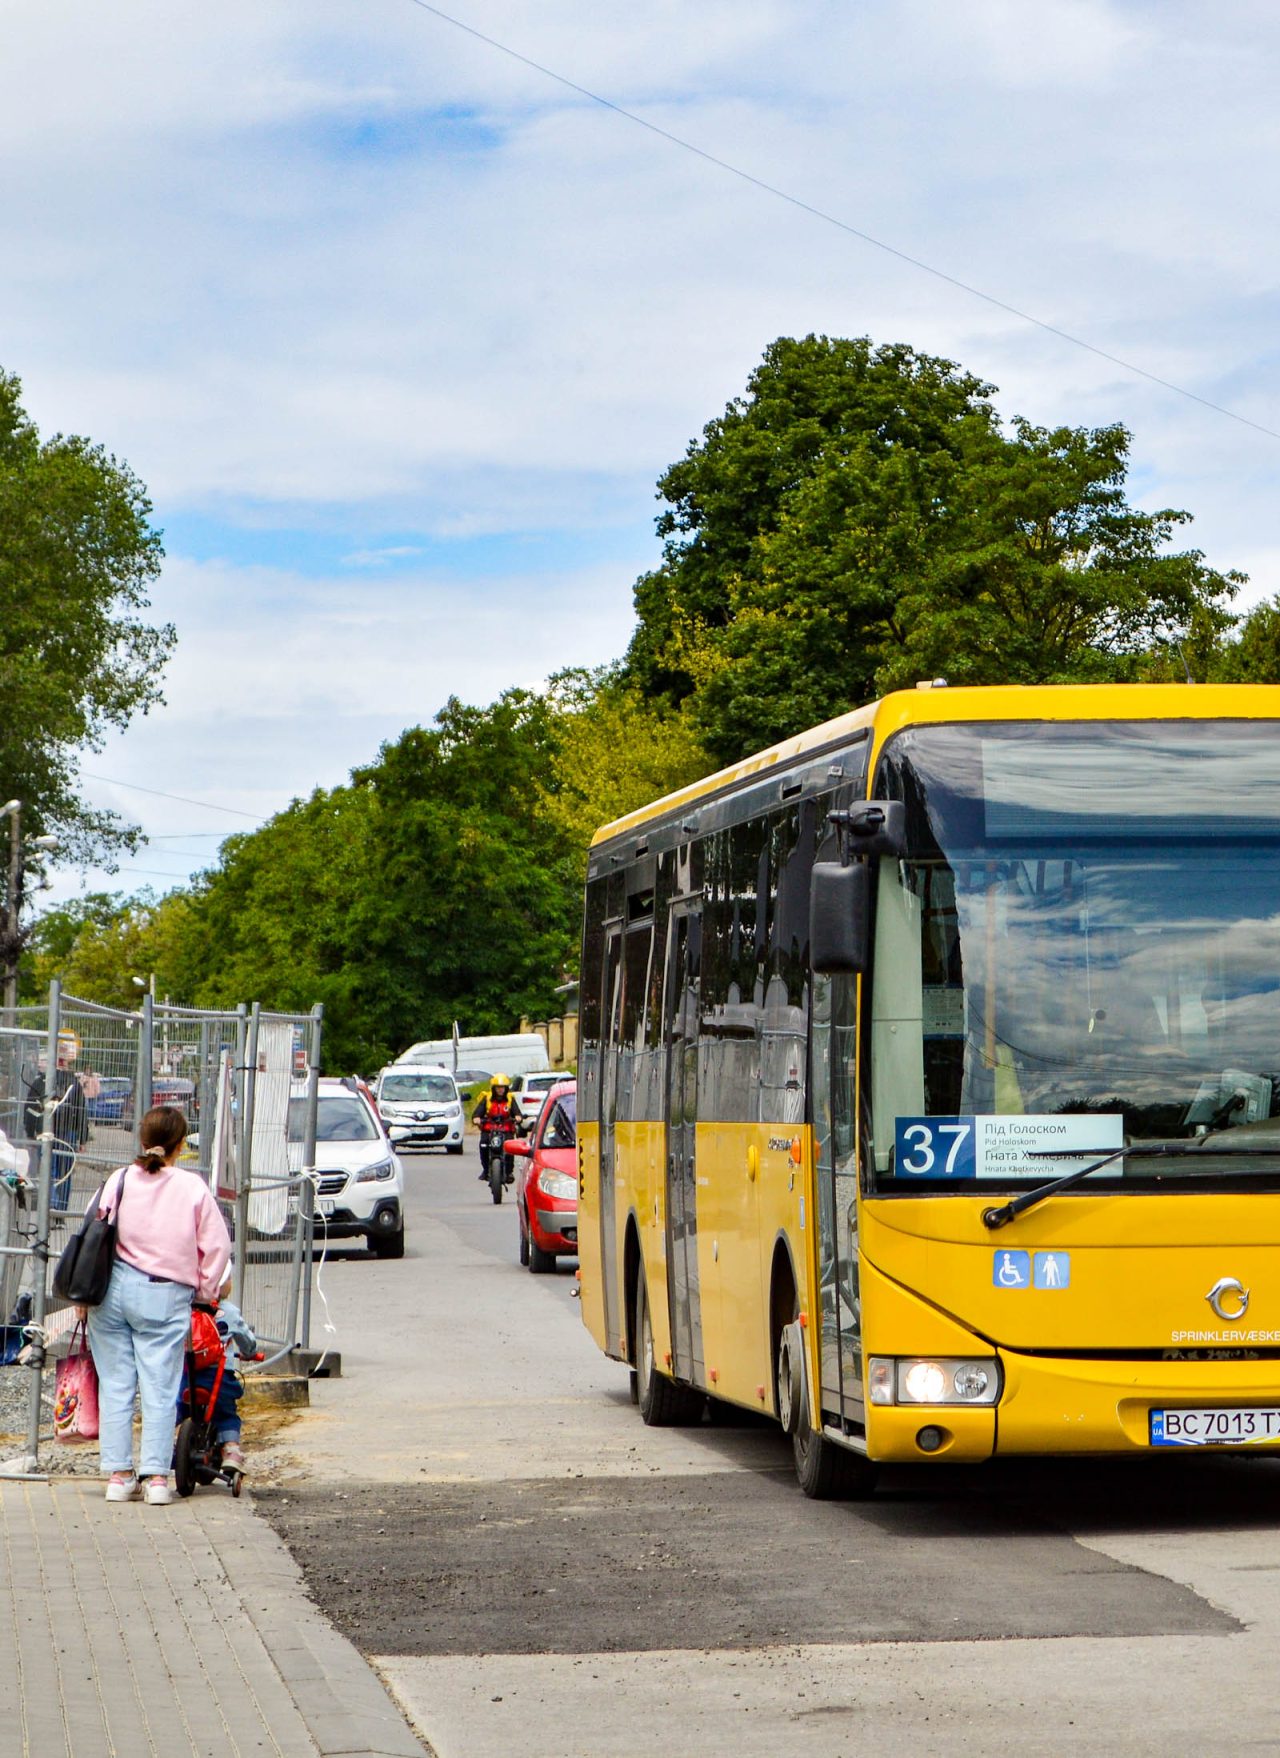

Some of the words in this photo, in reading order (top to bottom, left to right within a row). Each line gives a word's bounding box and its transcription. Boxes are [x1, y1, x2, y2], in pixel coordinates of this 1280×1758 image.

[985, 1123, 1006, 1136] Під
[1009, 1123, 1067, 1134] Голоском
[902, 1124, 971, 1173] 37
[985, 1138, 997, 1146] Pid
[999, 1138, 1037, 1146] Holoskom
[985, 1150, 1018, 1161] Гната
[1153, 1428, 1163, 1436] UA
[1166, 1414, 1198, 1435] BC
[1203, 1413, 1255, 1434] 7013
